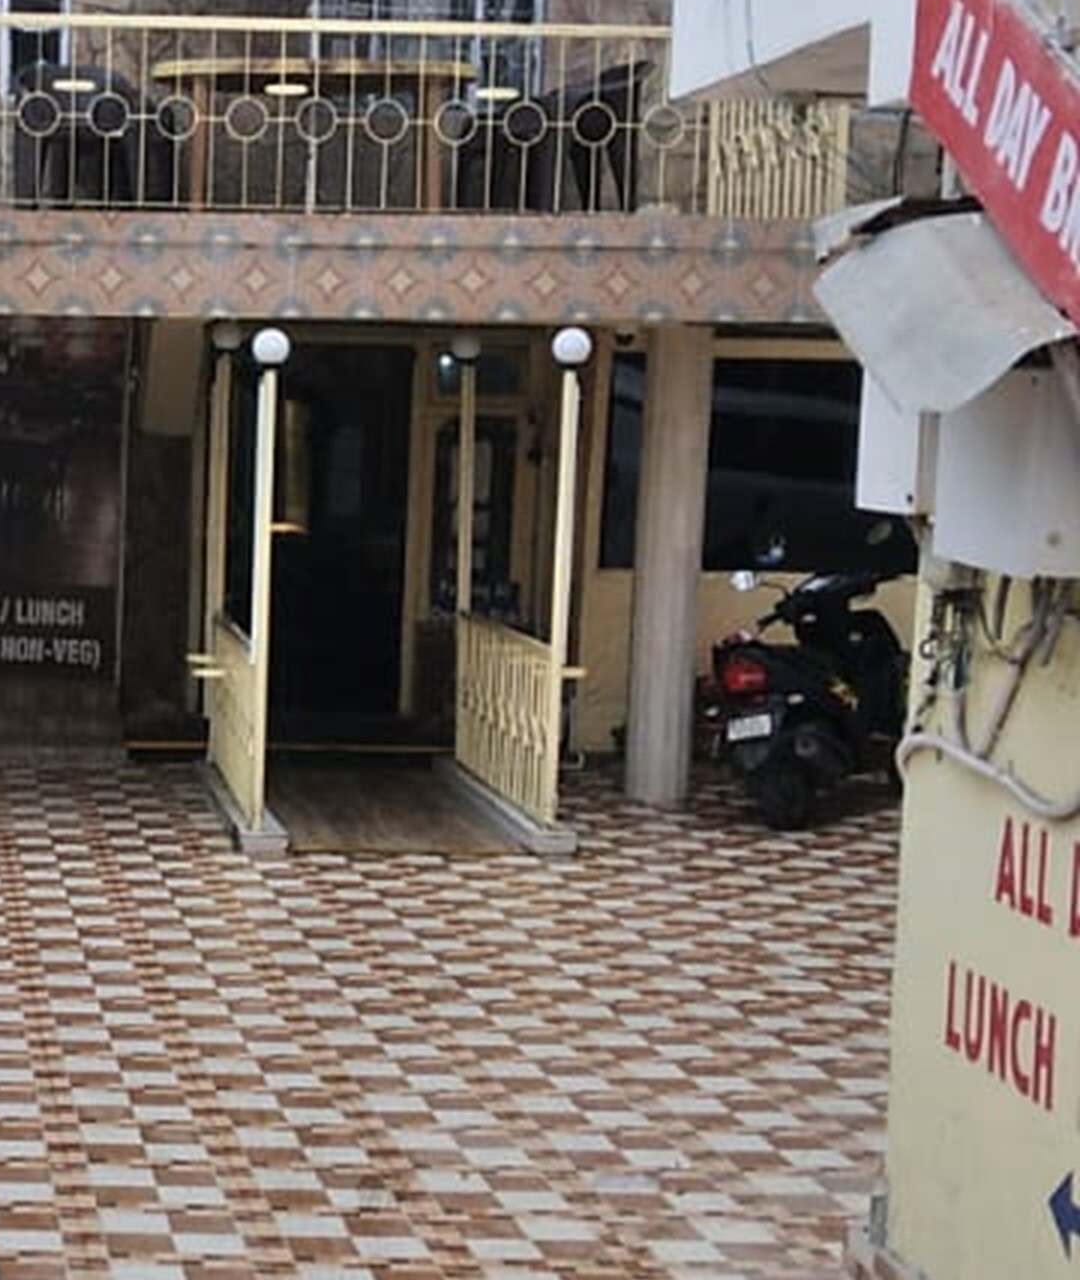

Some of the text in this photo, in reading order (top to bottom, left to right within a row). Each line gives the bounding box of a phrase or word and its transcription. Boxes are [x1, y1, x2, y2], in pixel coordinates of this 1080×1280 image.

[931, 0, 988, 128] ALL
[982, 56, 1053, 192] DAY
[0, 636, 102, 671] NON-VEG)
[15, 596, 86, 629] LUNCH
[993, 815, 1053, 926] ALL
[944, 958, 1056, 1112] LUNCH
